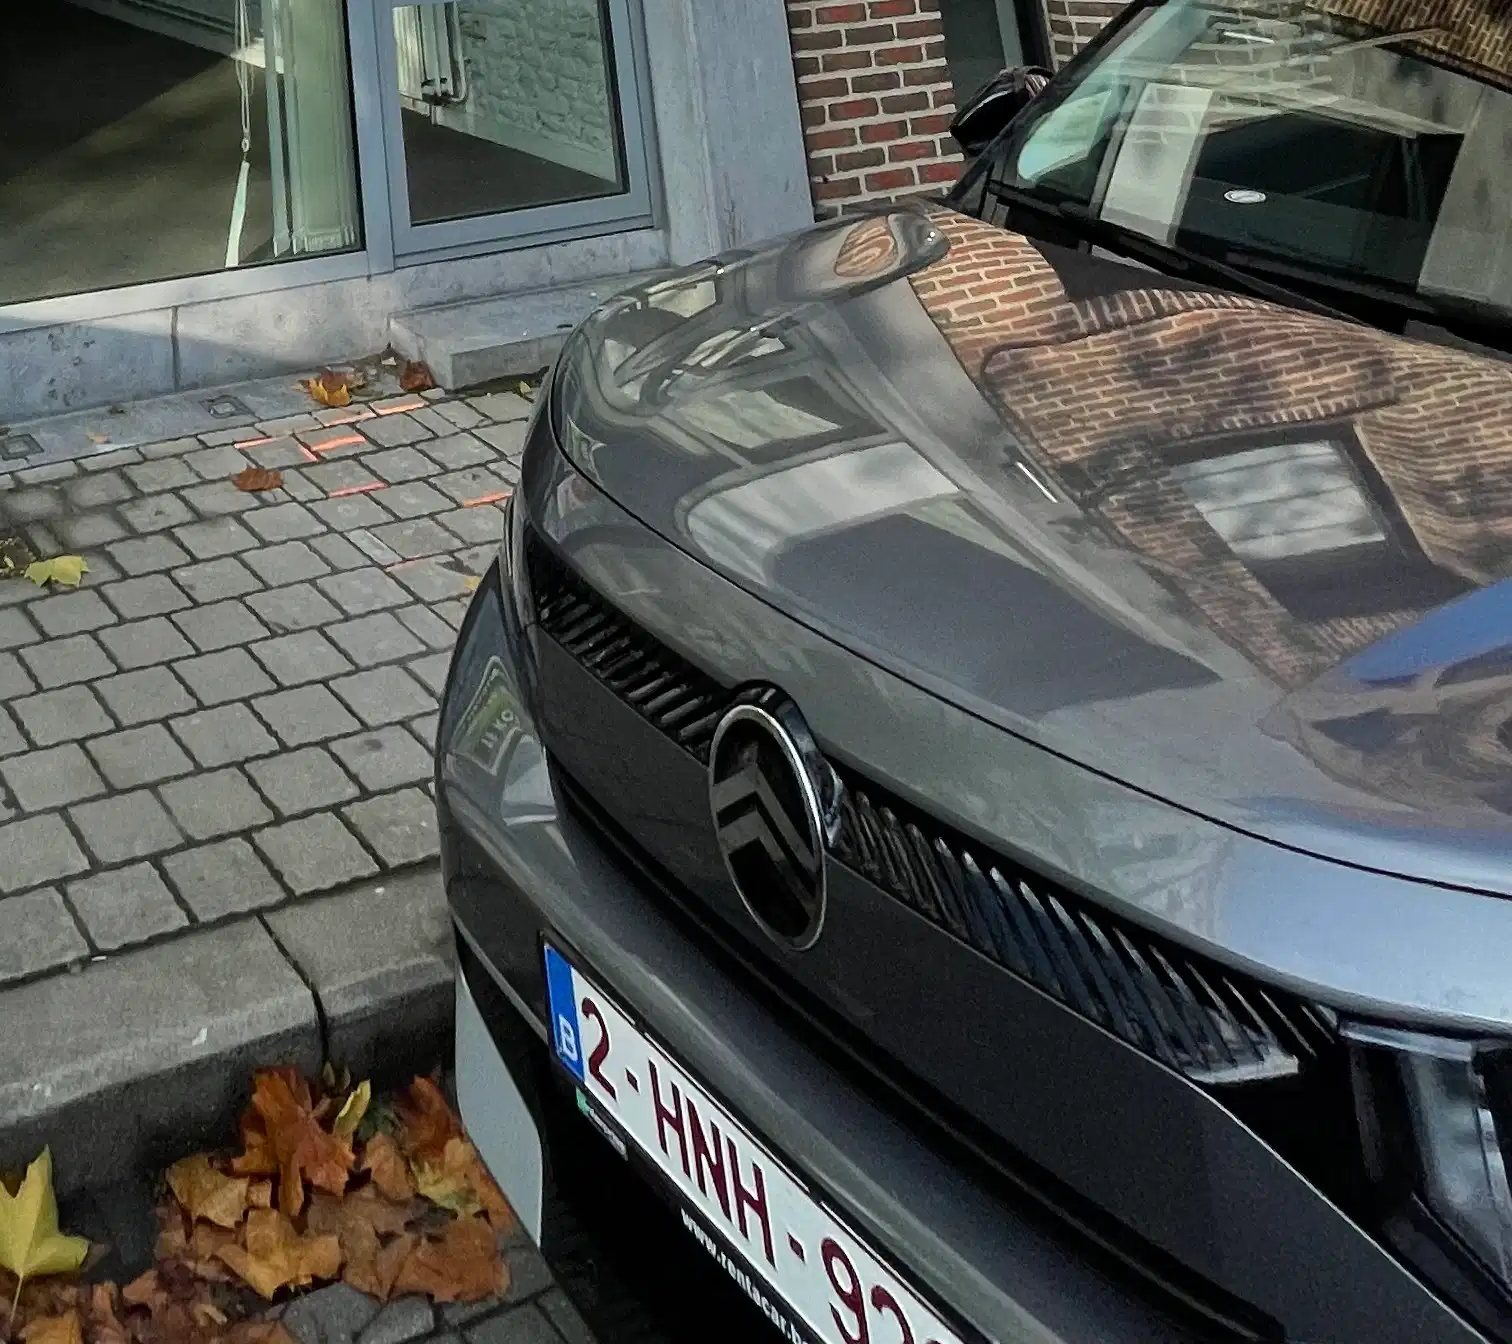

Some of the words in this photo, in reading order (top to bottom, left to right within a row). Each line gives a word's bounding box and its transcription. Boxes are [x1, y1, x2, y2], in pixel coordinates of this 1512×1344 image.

[558, 1013, 578, 1062] B
[581, 996, 945, 1344] 2-HNH-92
[680, 1205, 811, 1344] www.rentacar.b
